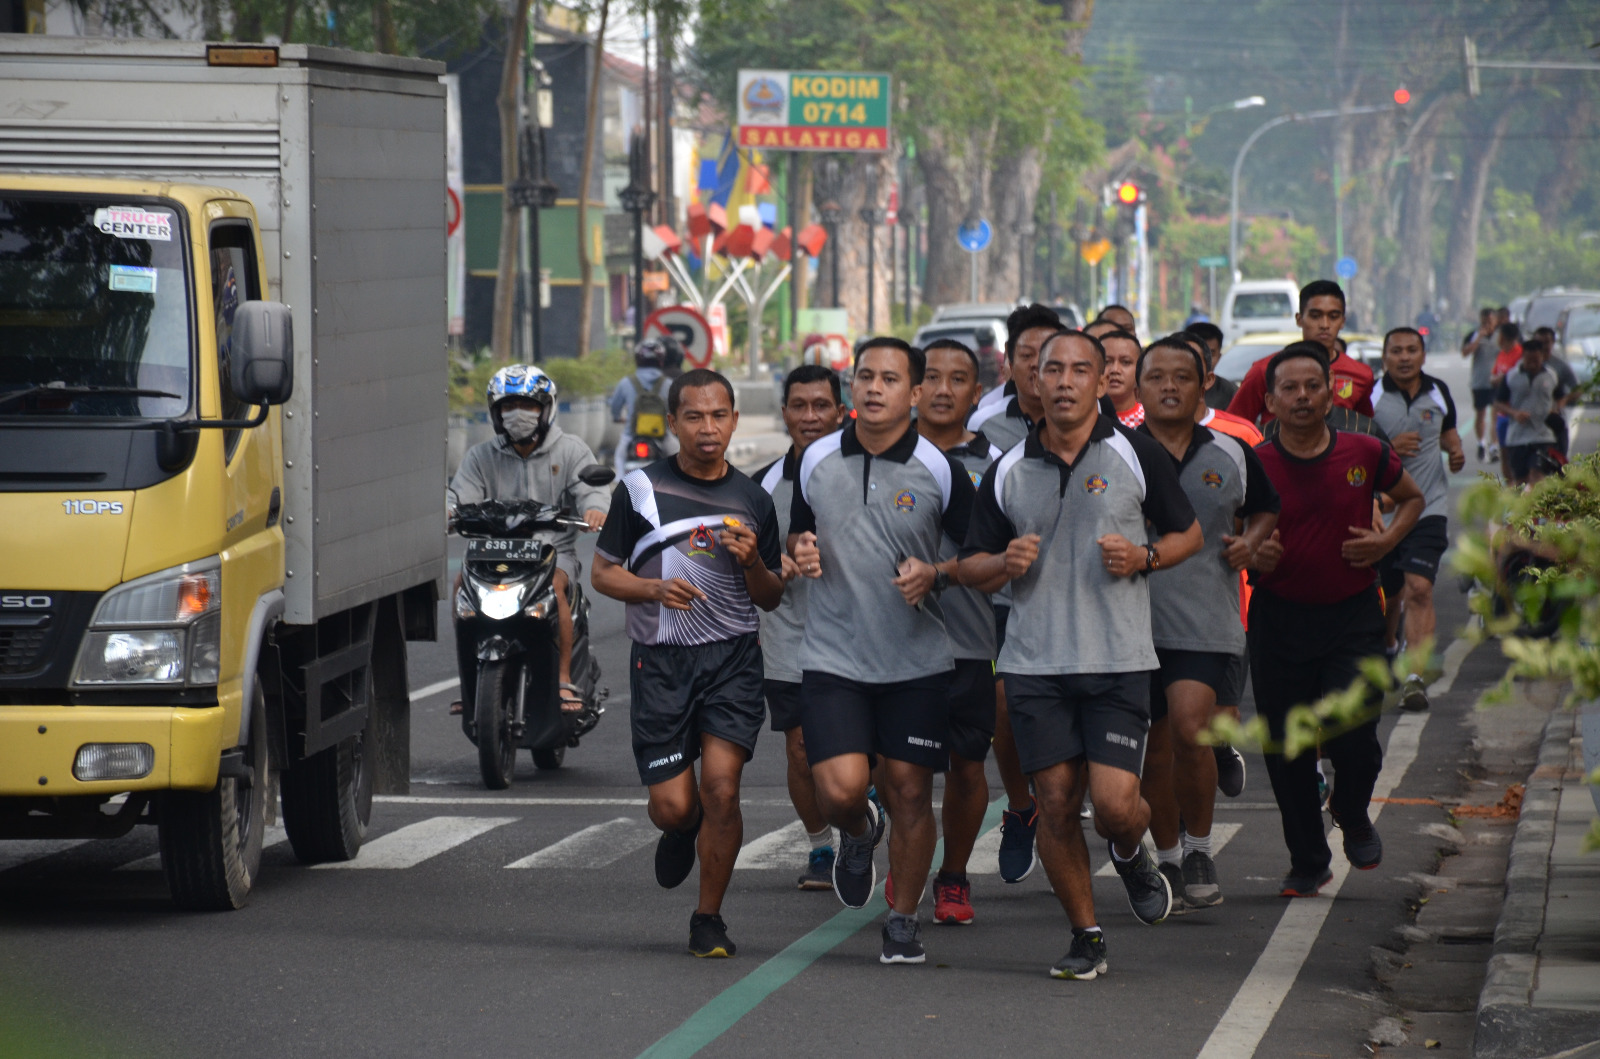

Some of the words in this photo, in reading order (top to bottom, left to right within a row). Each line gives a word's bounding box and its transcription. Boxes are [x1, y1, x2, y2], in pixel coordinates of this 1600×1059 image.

[792, 77, 879, 98] KODIM
[803, 102, 867, 123] 0714
[746, 128, 881, 149] SALATIGA
[110, 211, 168, 225] TRUCK
[100, 222, 169, 236] CENTER
[62, 499, 123, 514] 110PS
[469, 540, 477, 550] H
[485, 540, 513, 550] 6361
[524, 540, 539, 550] FK
